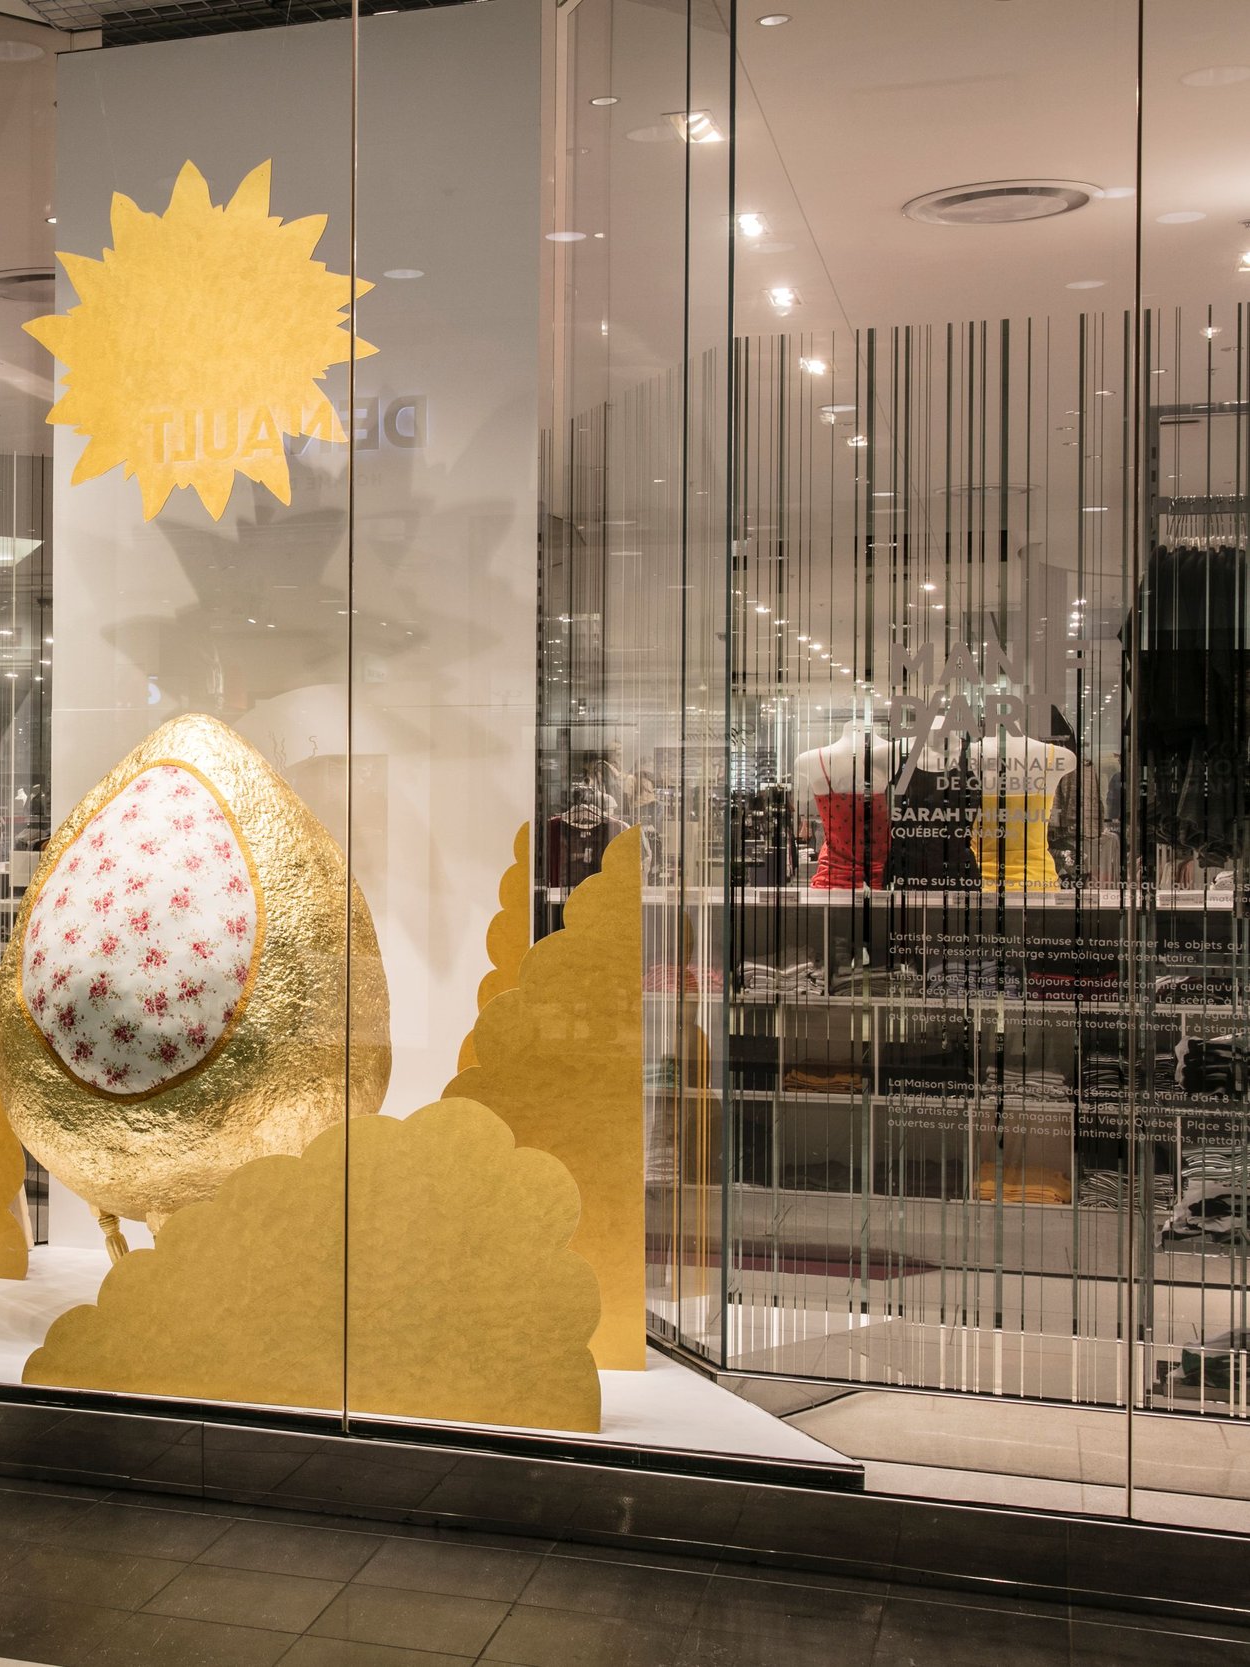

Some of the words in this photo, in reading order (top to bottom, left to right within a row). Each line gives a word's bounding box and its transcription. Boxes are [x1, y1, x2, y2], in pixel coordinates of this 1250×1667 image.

[936, 758, 961, 772] LA
[968, 757, 1066, 772] BIENNALE
[936, 777, 961, 791] DE
[966, 773, 1047, 792] QUÉBEC
[891, 807, 960, 822] SARAH
[964, 807, 1062, 824] THIBAULT
[890, 825, 951, 840] (QUÉBEC,
[954, 828, 1018, 840] CANAD
[892, 875, 904, 886] Je
[908, 877, 928, 886] me
[931, 875, 956, 887] suis
[960, 877, 1014, 890] toujours
[1018, 877, 1084, 890] considéré
[1088, 880, 1137, 890] comme
[889, 932, 933, 942] L'artiste
[937, 933, 970, 943] Sarah
[974, 934, 1021, 945] Thibault
[1026, 936, 1072, 946] s'amuse
[1076, 937, 1084, 946] à
[1089, 938, 1158, 949] transformer
[1164, 939, 1180, 949] les
[1185, 940, 1222, 951] objets
[889, 946, 911, 955] d'en
[915, 946, 940, 956] faire
[943, 947, 989, 957] ressortir
[992, 948, 1002, 957] la
[1005, 949, 1045, 960] charge
[1048, 950, 1114, 962] symbolique
[1117, 952, 1130, 961] et
[889, 973, 959, 983] L'instalation
[962, 975, 976, 983] Je
[978, 976, 996, 984] me
[999, 975, 1020, 985] suis
[1024, 977, 1070, 988] toujours
[1074, 978, 1130, 988] considéré
[1134, 981, 1177, 990] comme
[1018, 991, 1039, 999] une
[1045, 992, 1084, 1001] nature
[1090, 992, 1152, 1003] artificielle.
[1159, 995, 1173, 1004] La
[1180, 995, 1216, 1006] scène,
[1224, 997, 1232, 1005] à
[911, 1013, 947, 1024] objets
[949, 1014, 964, 1023] de
[1056, 1019, 1081, 1028] sans
[1085, 1020, 1136, 1030] toutefois
[1193, 1024, 1202, 1033] à
[888, 1078, 901, 1087] La
[905, 1079, 944, 1090] Maison
[947, 1081, 986, 1091] Simons
[1142, 1091, 1150, 1100] à
[1154, 1092, 1188, 1102] Manif
[1191, 1093, 1219, 1103] d'art
[1222, 1095, 1229, 1104] 8
[888, 1105, 913, 1114] neuf
[917, 1106, 959, 1117] artistes
[963, 1107, 990, 1119] dans
[994, 1111, 1014, 1120] nos
[1019, 1112, 1074, 1123] magasins
[1078, 1115, 1094, 1124] du
[1098, 1116, 1130, 1126] Vieux
[1187, 1120, 1220, 1131] Place
[888, 1119, 935, 1129] ouvertes
[938, 1121, 954, 1130] sur
[1013, 1124, 1027, 1134] de
[1030, 1126, 1050, 1135] nos
[1053, 1126, 1076, 1137] plus
[1079, 1128, 1122, 1140] intimes
[1125, 1133, 1194, 1144] aspirations,
[1197, 1135, 1246, 1147] mettant
